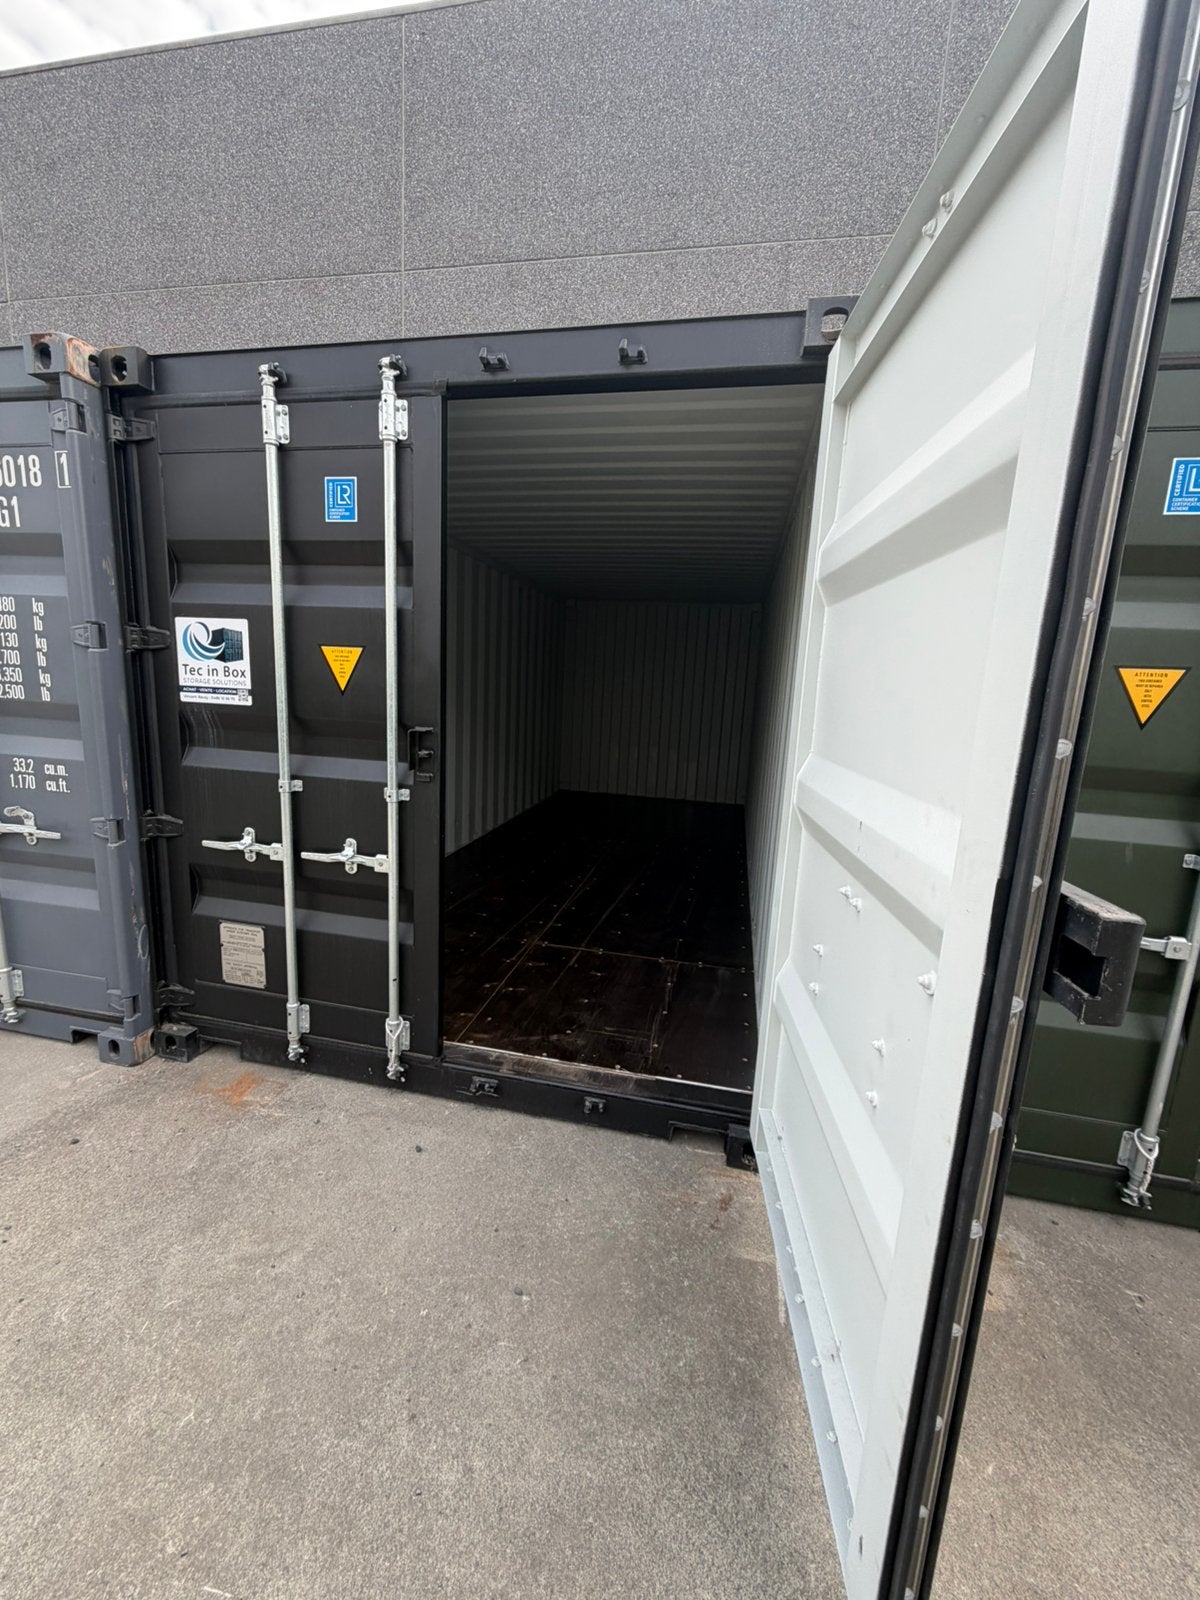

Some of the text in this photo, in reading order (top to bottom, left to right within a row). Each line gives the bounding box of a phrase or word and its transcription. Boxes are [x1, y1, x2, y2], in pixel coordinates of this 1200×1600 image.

[0, 452, 70, 488] 018 1
[337, 485, 351, 505] LR
[32, 597, 45, 617] kg
[33, 615, 43, 631] lb
[35, 633, 48, 652] kg
[37, 651, 47, 667] lb
[0, 667, 51, 687] .350 kg
[182, 663, 247, 679] Tec in Box
[183, 677, 247, 687] STORAGE SOLUTIONS
[41, 686, 51, 702] lb
[13, 757, 69, 777] 33.2 cu.m.
[9, 773, 71, 793] 1.170 cu.ft.
